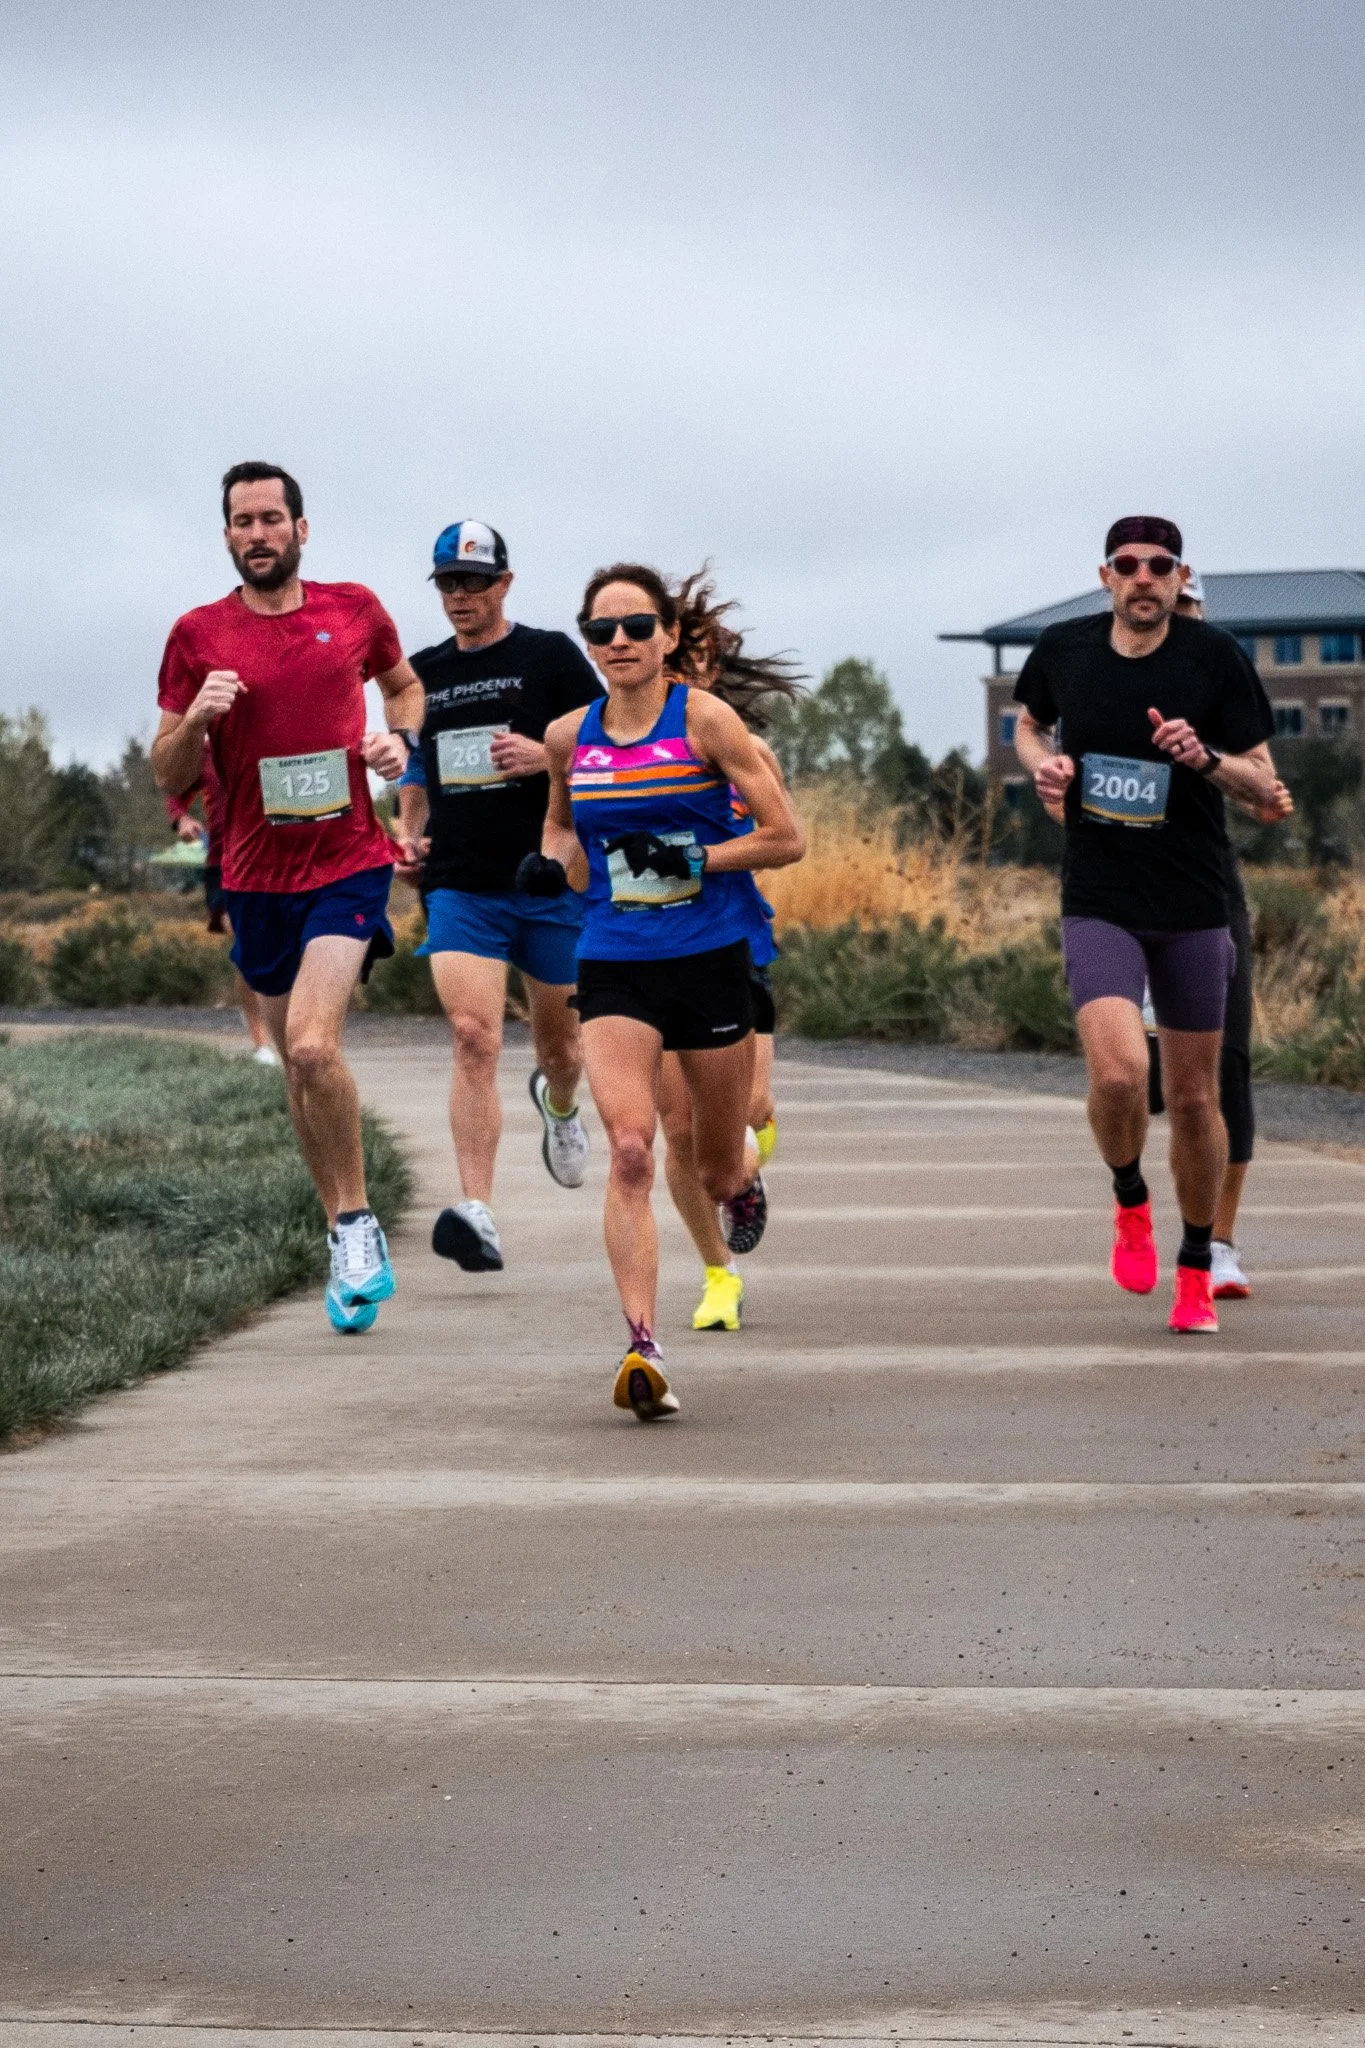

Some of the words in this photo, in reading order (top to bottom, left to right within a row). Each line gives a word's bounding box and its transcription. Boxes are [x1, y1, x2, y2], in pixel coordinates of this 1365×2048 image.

[452, 676, 523, 699] PHOENIX
[452, 743, 492, 768] 26
[280, 769, 331, 798] 125
[1089, 773, 1157, 804] 2004
